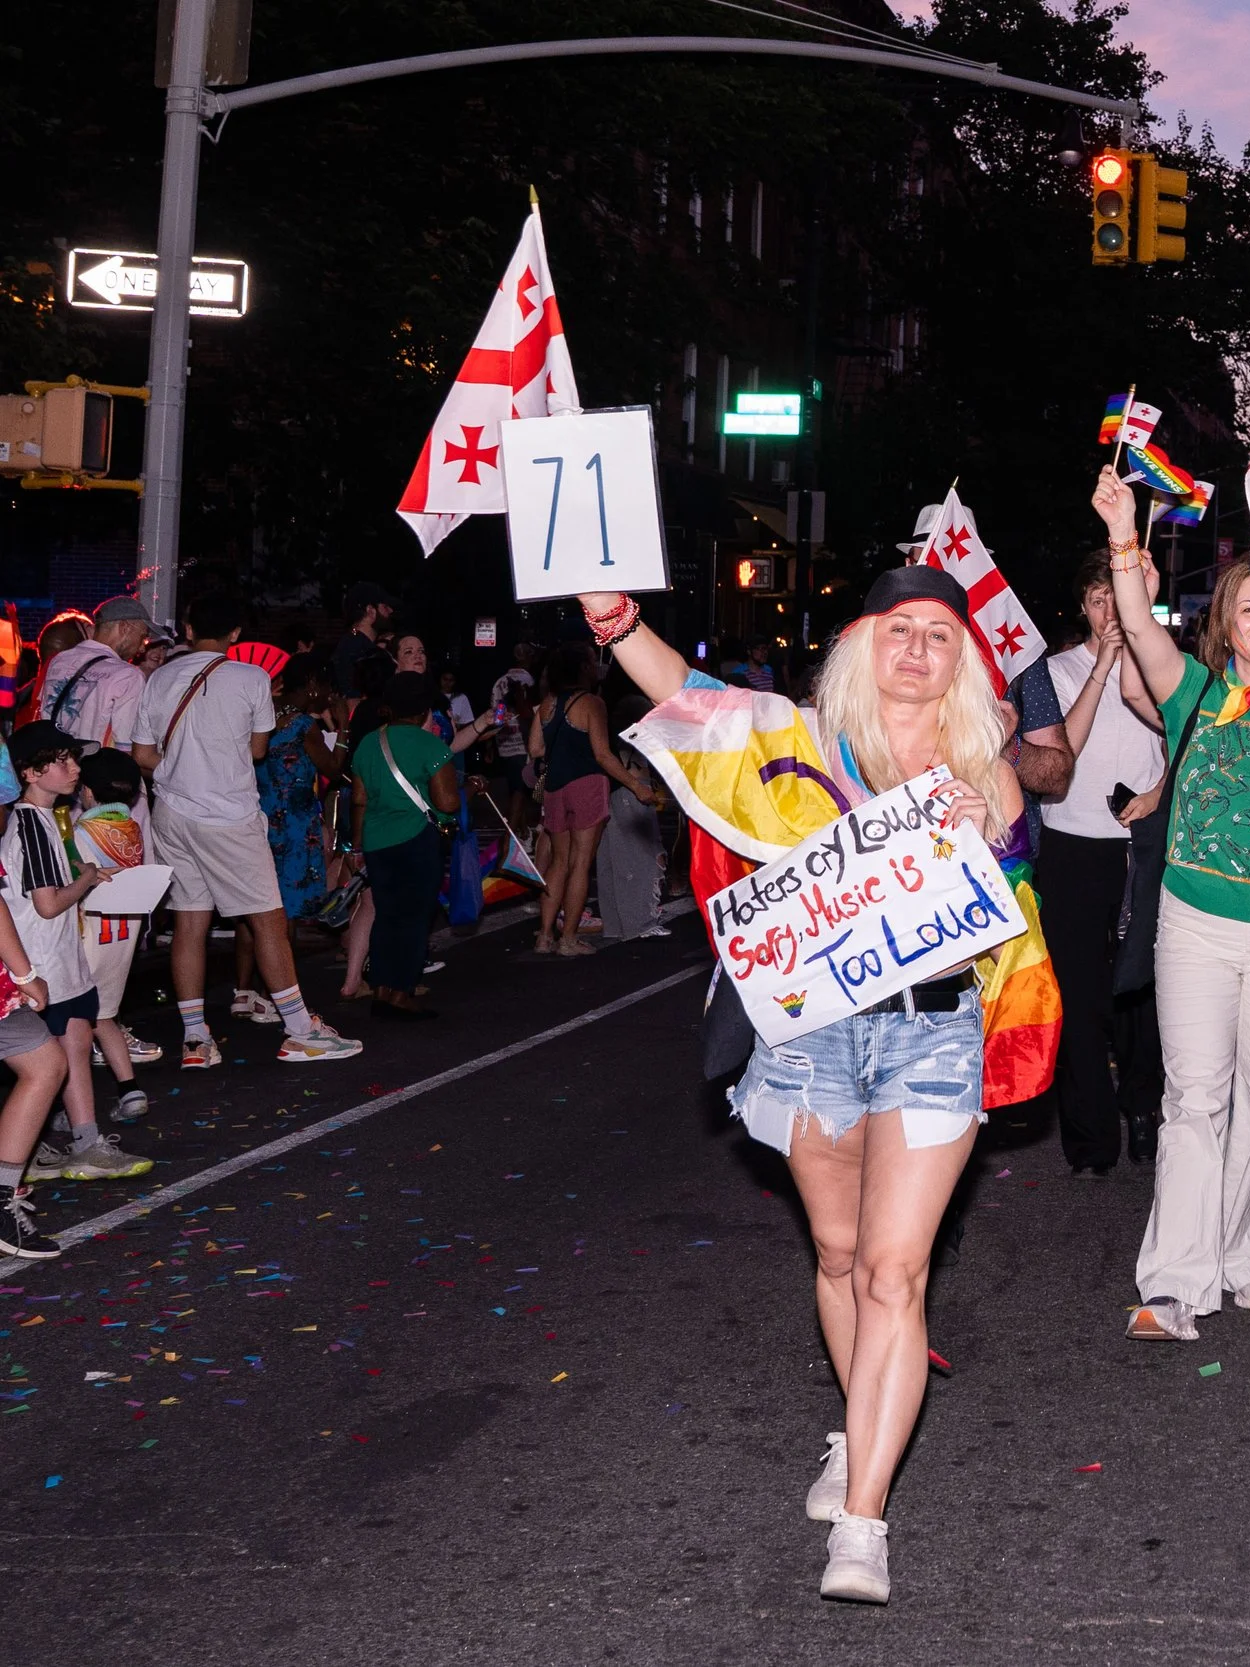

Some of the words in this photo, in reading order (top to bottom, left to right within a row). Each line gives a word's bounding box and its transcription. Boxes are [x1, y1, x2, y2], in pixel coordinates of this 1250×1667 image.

[104, 270, 156, 293] ONE
[190, 277, 220, 296] AY
[533, 453, 615, 570] 71
[1128, 445, 1159, 471] LOVE
[1157, 468, 1183, 492] WINS
[713, 866, 803, 937] Haters
[805, 824, 845, 885] cry
[799, 883, 886, 937] Music
[889, 855, 924, 892] is
[804, 928, 883, 1006] Too
[881, 862, 1009, 967] Loud
